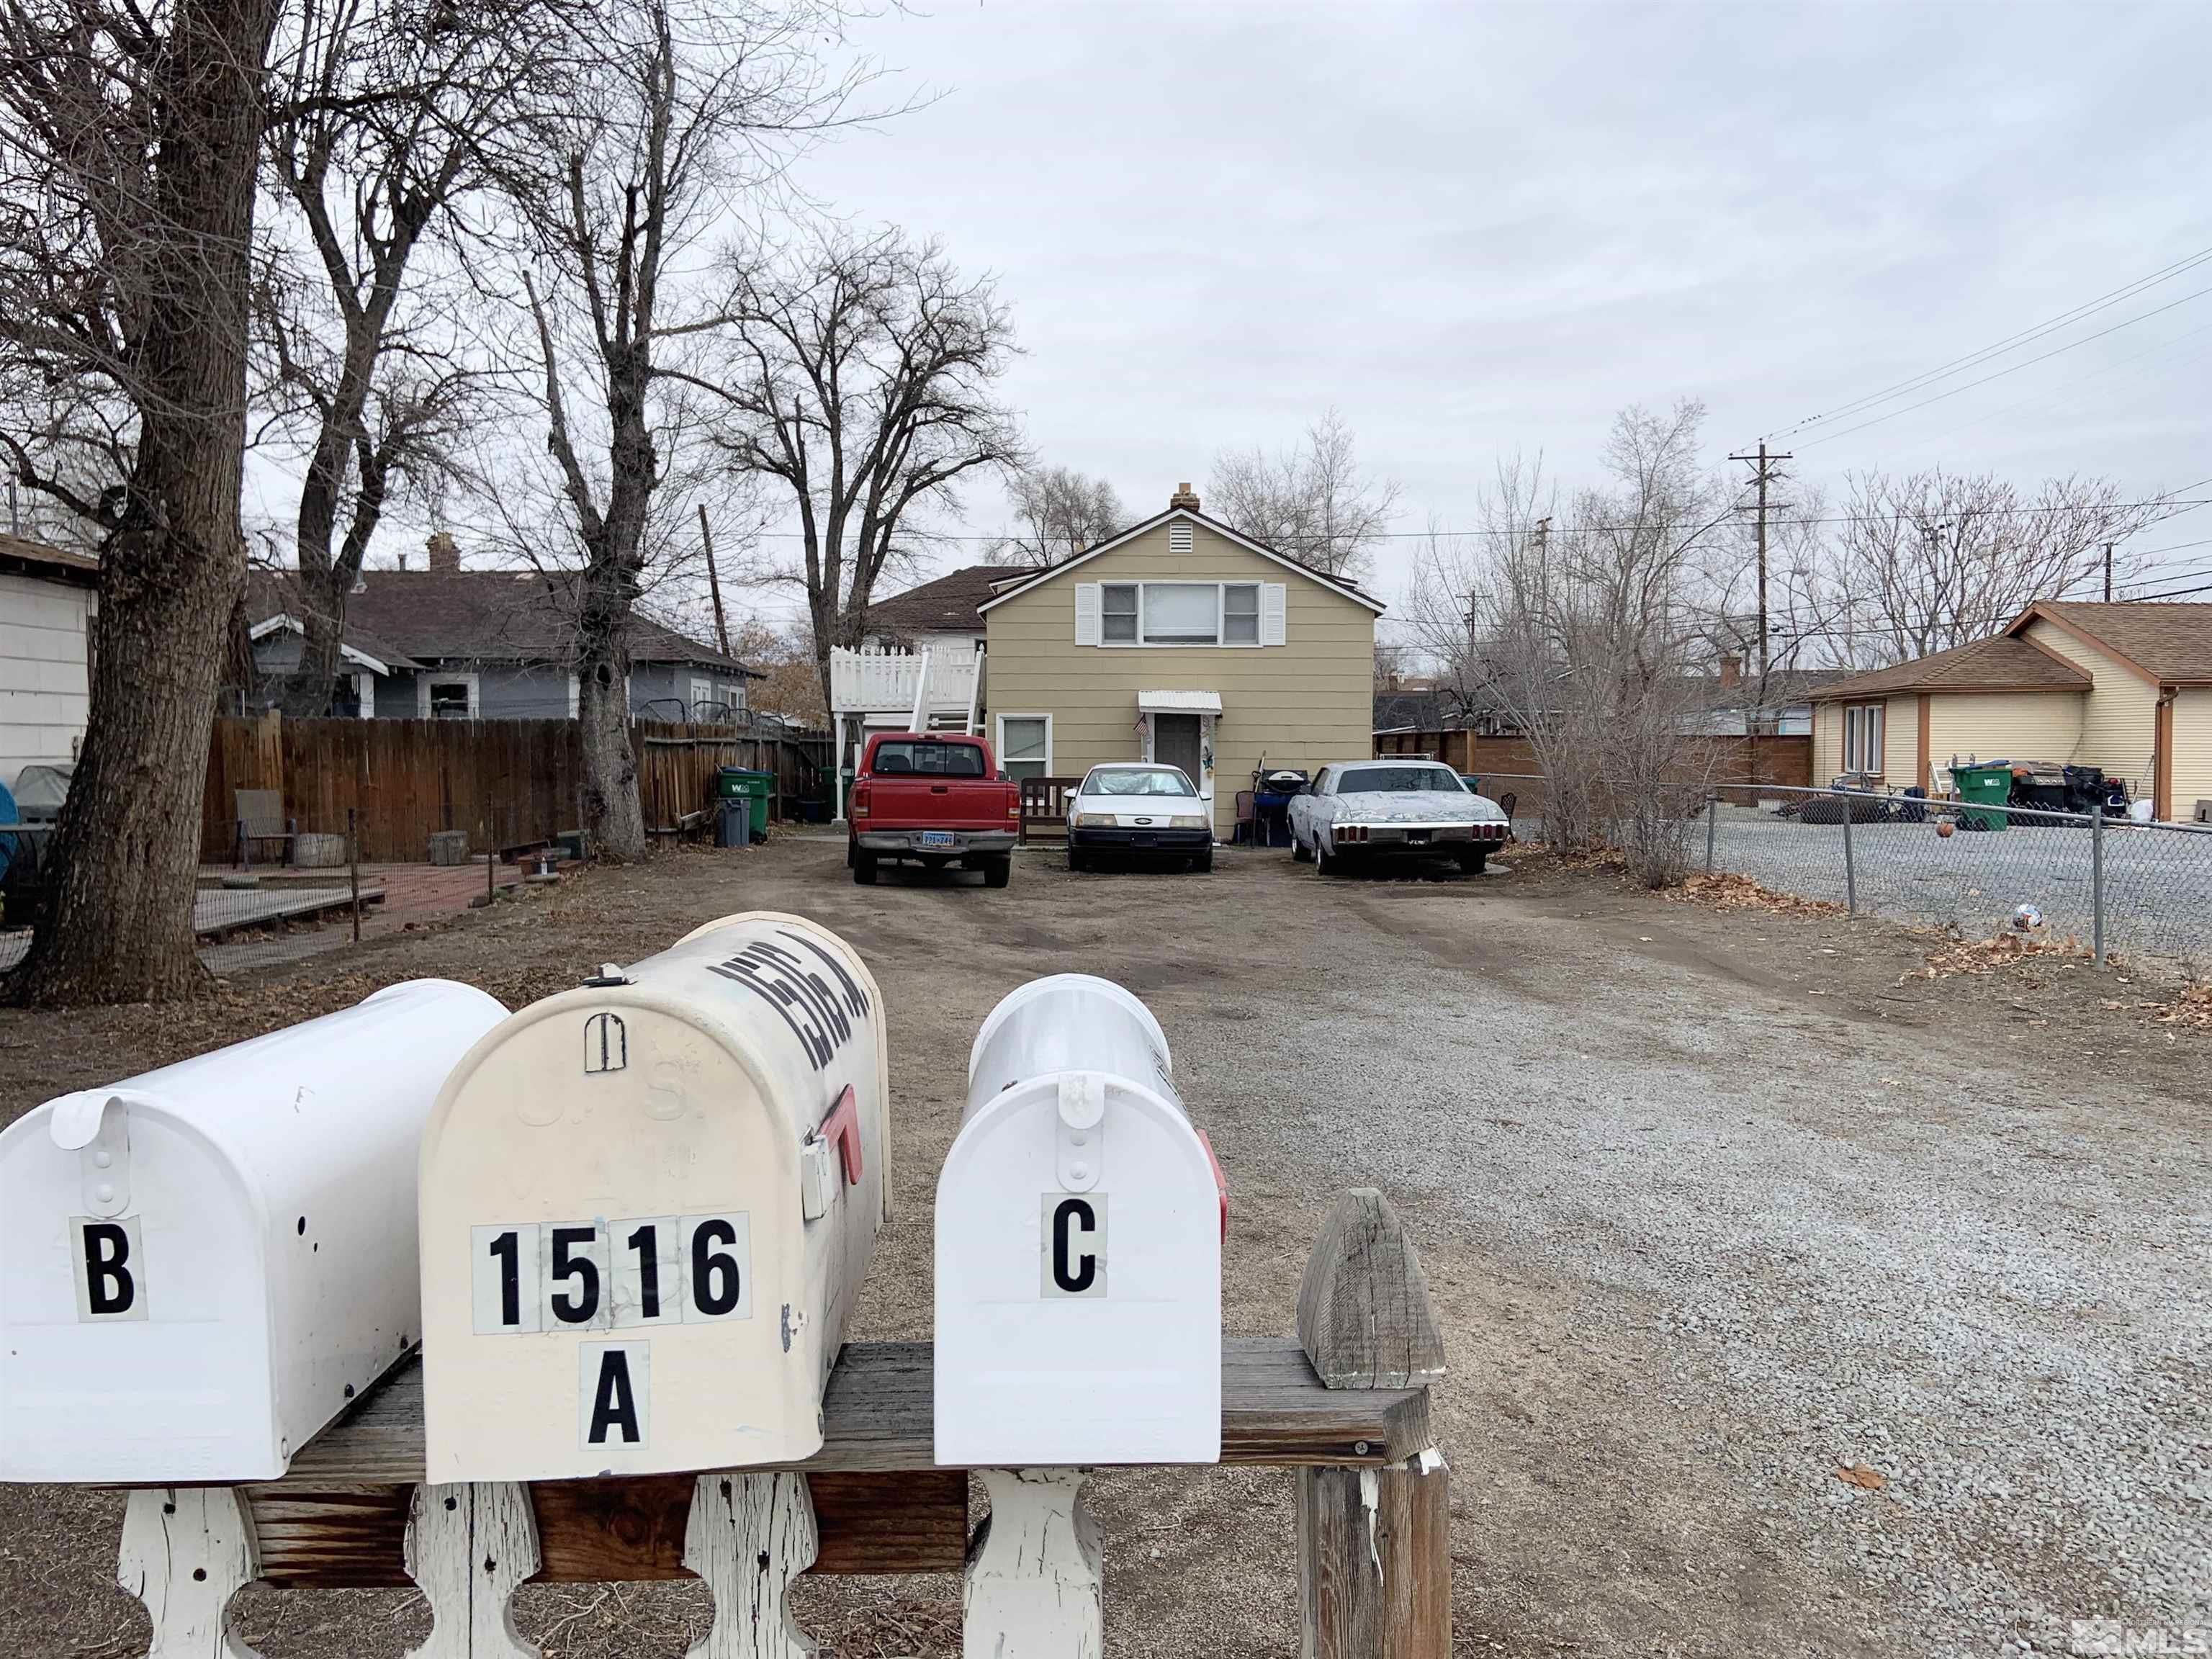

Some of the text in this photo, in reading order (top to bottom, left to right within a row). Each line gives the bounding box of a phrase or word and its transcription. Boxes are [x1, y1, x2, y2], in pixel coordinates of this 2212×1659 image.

[84, 1223, 134, 1314] B
[490, 1219, 739, 1326] 1516
[1053, 1198, 1095, 1292] C
[588, 1350, 640, 1444] A
